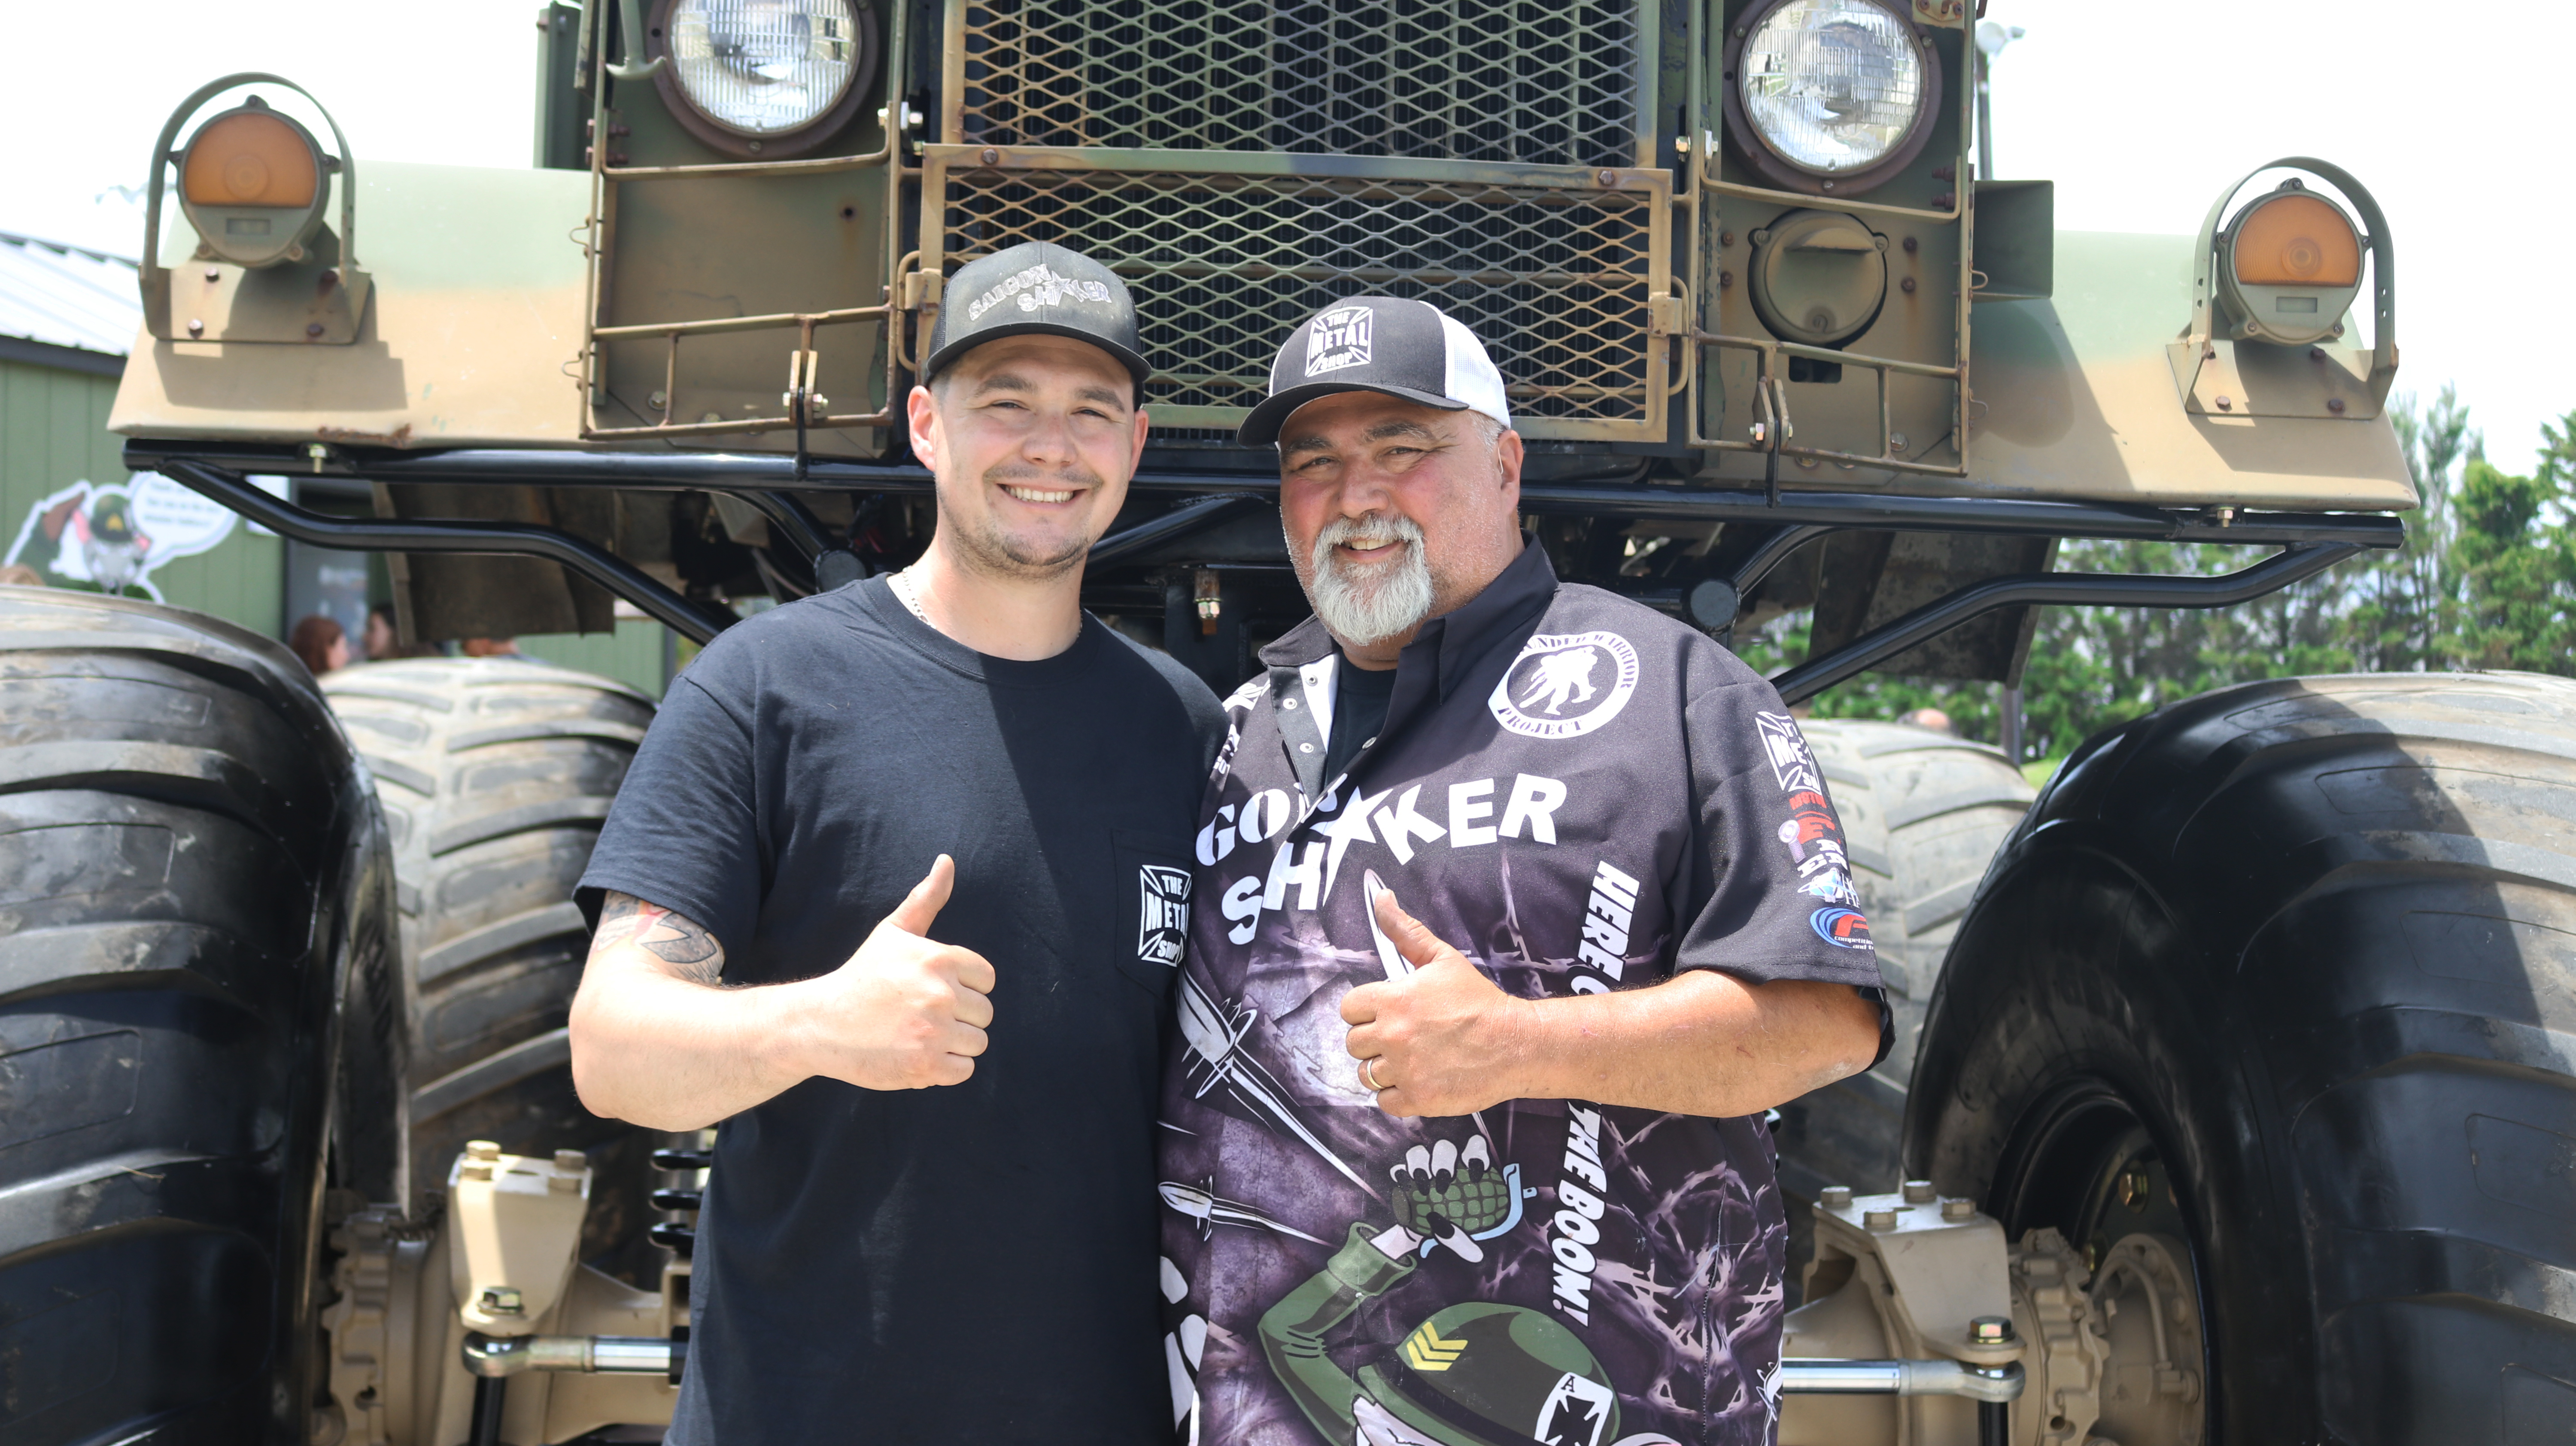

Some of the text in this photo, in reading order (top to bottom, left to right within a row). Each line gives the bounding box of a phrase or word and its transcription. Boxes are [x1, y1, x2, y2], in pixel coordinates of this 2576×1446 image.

[968, 263, 1051, 321] SAIGON
[1327, 312, 1350, 327] THE
[1310, 322, 1368, 359] METAL
[1320, 352, 1353, 370] SHOP
[1497, 707, 1581, 735] PROJECT
[1161, 875, 1183, 896] THE
[1577, 860, 1640, 982] HERE
[1552, 1179, 1605, 1327] BOOM!
